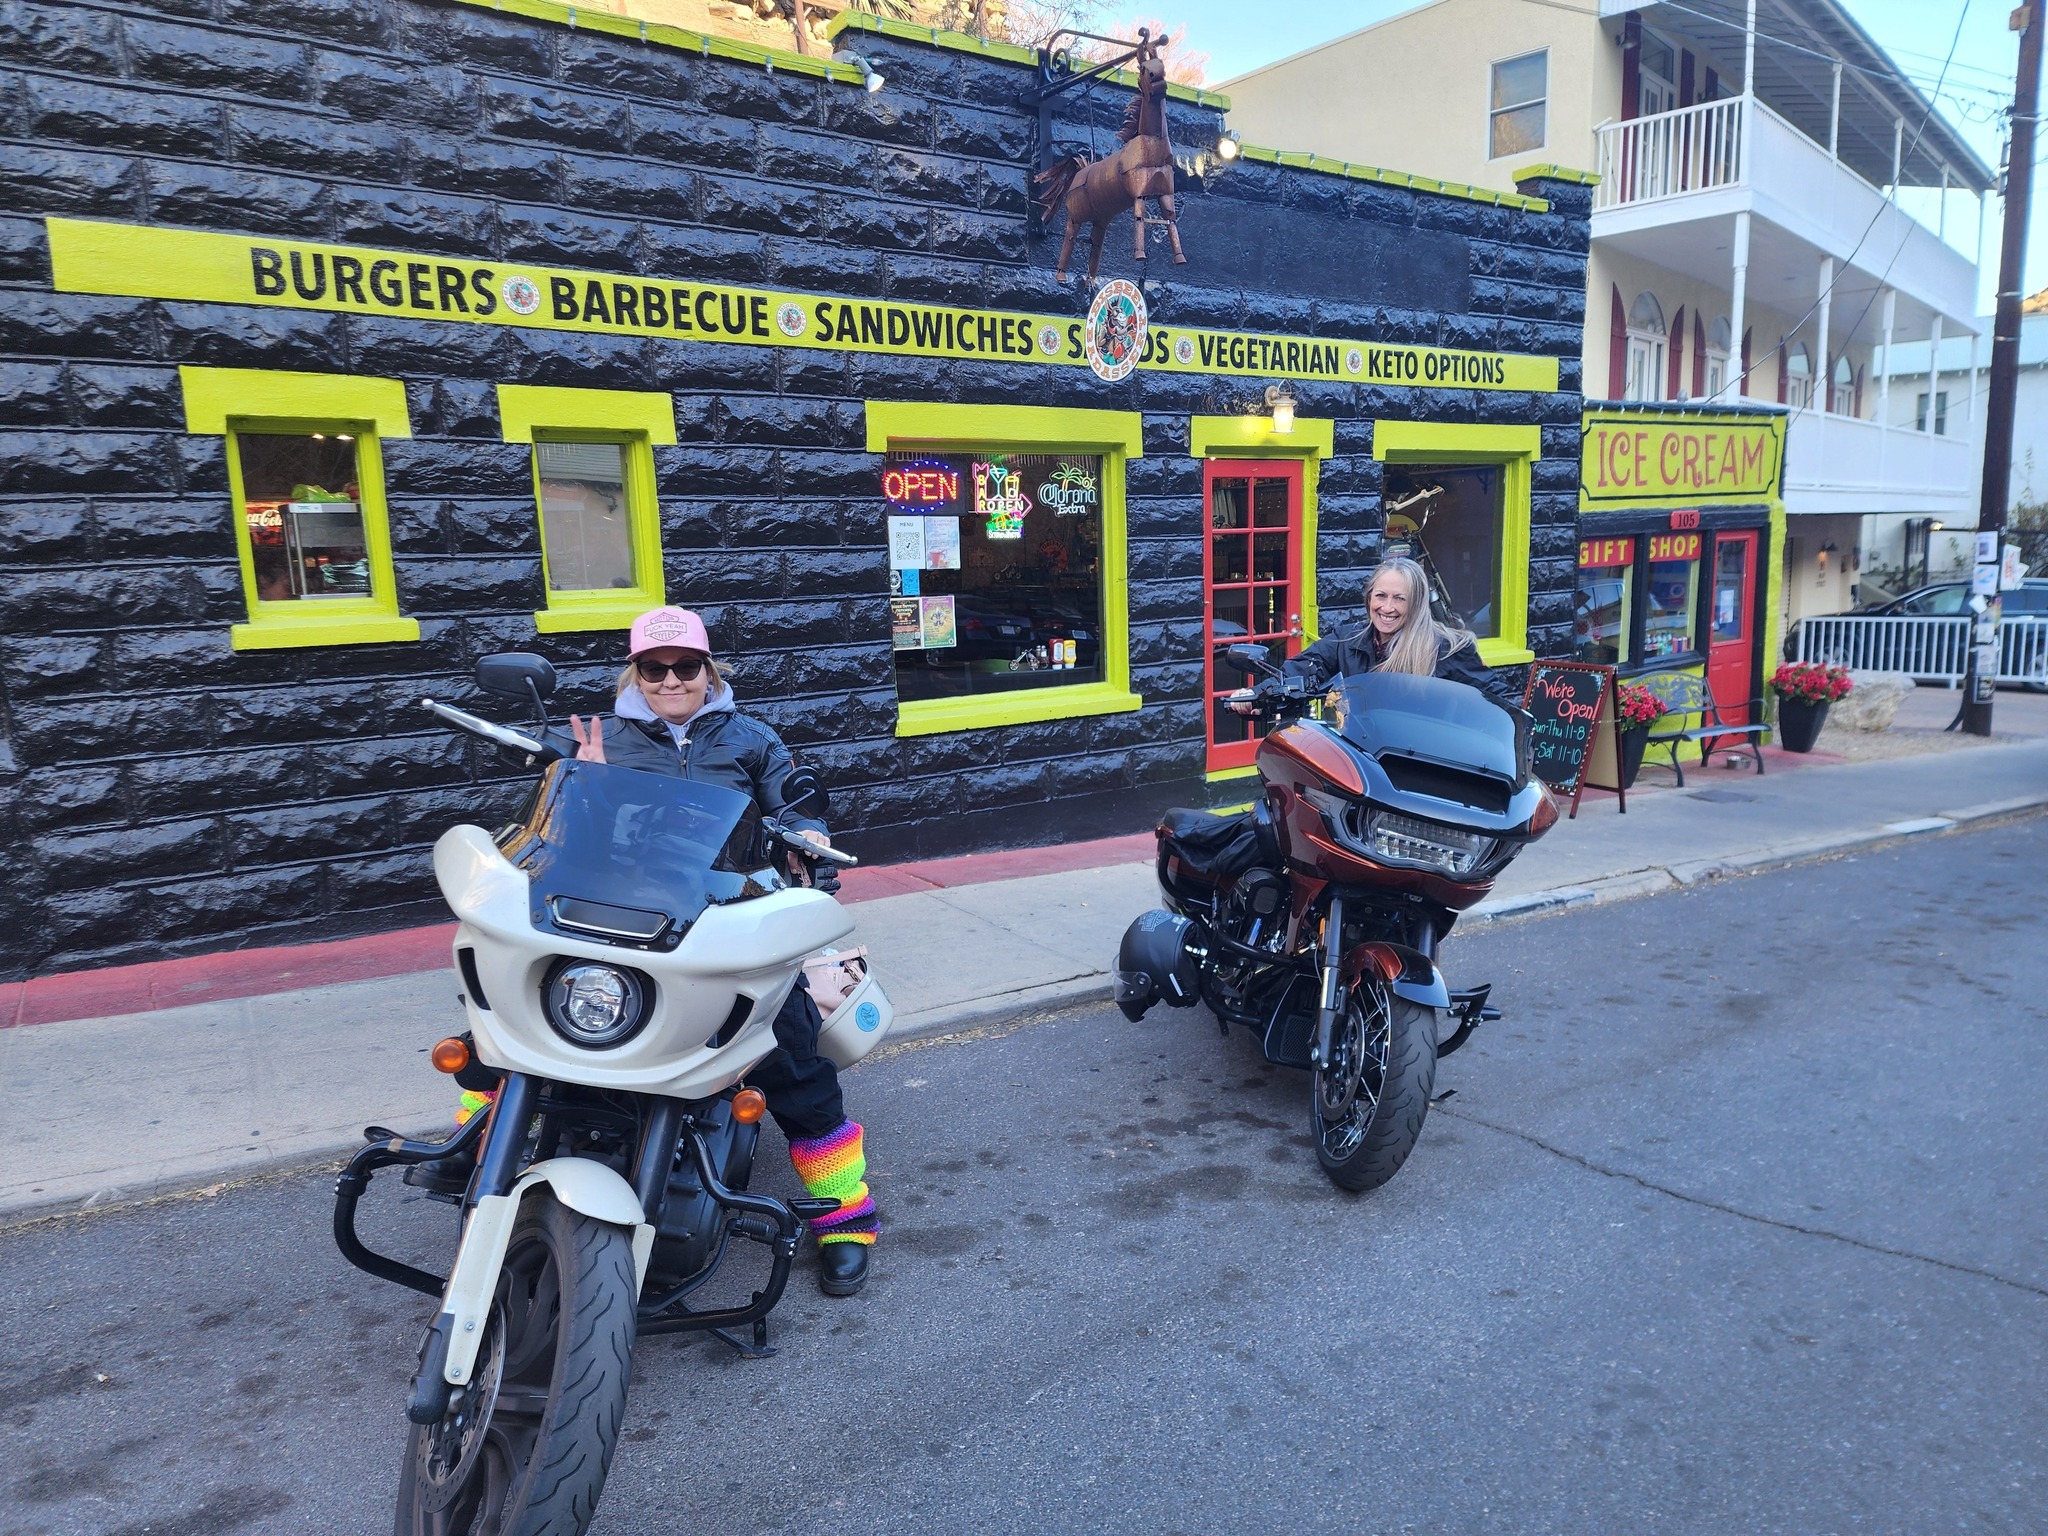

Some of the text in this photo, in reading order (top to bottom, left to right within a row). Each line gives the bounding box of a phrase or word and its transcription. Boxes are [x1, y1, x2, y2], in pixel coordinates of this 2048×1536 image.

[251, 247, 497, 315] BURGERS
[551, 277, 769, 337] BARBECUE
[816, 302, 1033, 355] SANDWICHES
[1199, 334, 1340, 375] VEGETARIAN
[1368, 349, 1418, 379] KETO
[1425, 352, 1505, 385] OPTIONS
[1597, 431, 1766, 488] ICE CREAM
[884, 472, 958, 500] OPEN
[1040, 483, 1097, 507] Corona
[987, 500, 1024, 512] OPEN
[1057, 503, 1086, 515] Extra
[1677, 514, 1695, 528] 105
[1579, 535, 1699, 565] GIFT SHOP
[1536, 675, 1576, 699] We're
[1557, 697, 1601, 723] Open!
[1565, 724, 1586, 741] 11-8
[1558, 745, 1582, 765] 11-10
